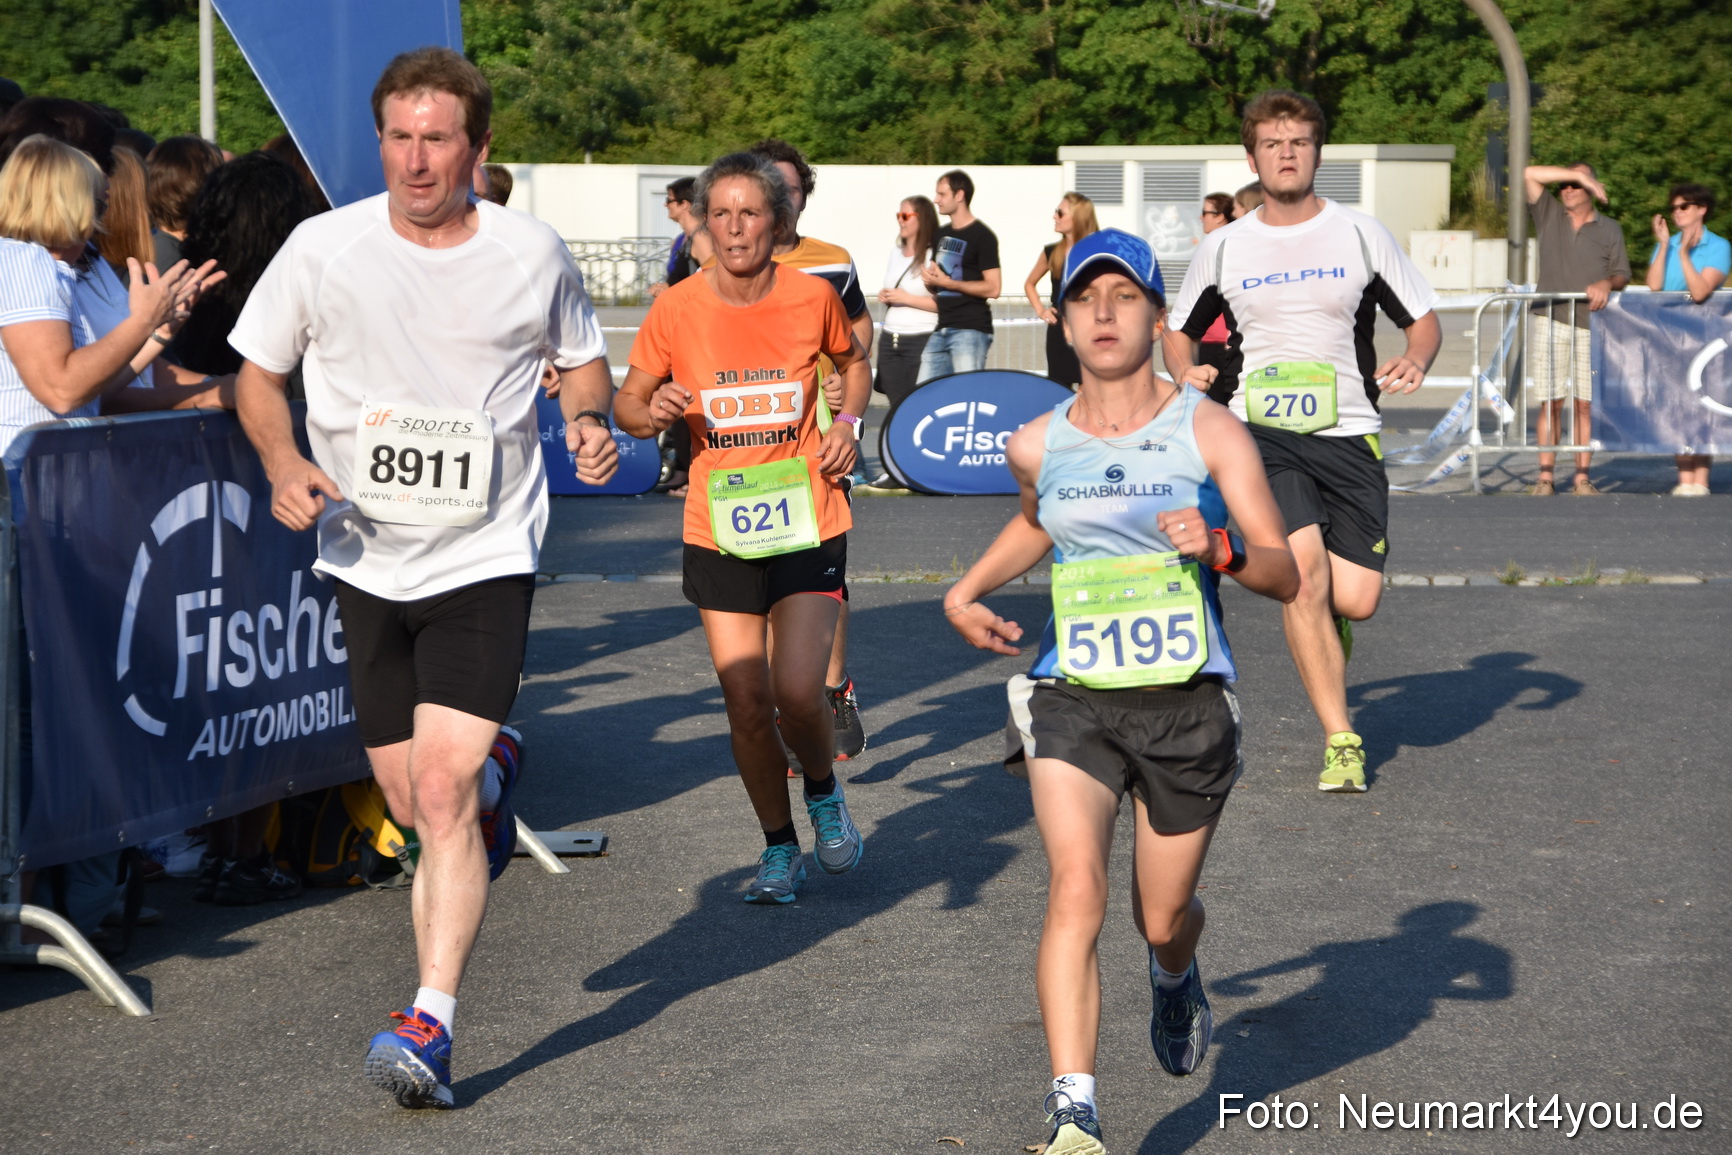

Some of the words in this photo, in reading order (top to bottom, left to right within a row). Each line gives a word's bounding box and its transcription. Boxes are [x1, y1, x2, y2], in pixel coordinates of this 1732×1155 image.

[1242, 267, 1345, 289] DELPHI
[715, 370, 738, 385] 30
[744, 367, 785, 382] Jahre
[709, 391, 797, 419] OBI
[1264, 393, 1318, 417] 270
[364, 408, 474, 434] df-sports
[944, 424, 1024, 452] Fisc
[369, 444, 471, 490] 8911
[958, 453, 1007, 467] AUTO
[358, 491, 483, 508] www.df-sports.de
[1057, 484, 1173, 500] SCHABMÜLLER
[731, 497, 790, 534] 621
[1101, 504, 1129, 513] TEAM
[735, 539, 760, 547] Sylvana
[761, 533, 797, 544] Kuhlemann
[1057, 566, 1096, 581] 2014
[1068, 613, 1198, 670] 5195
[187, 686, 356, 761] AUTOMOBIL
